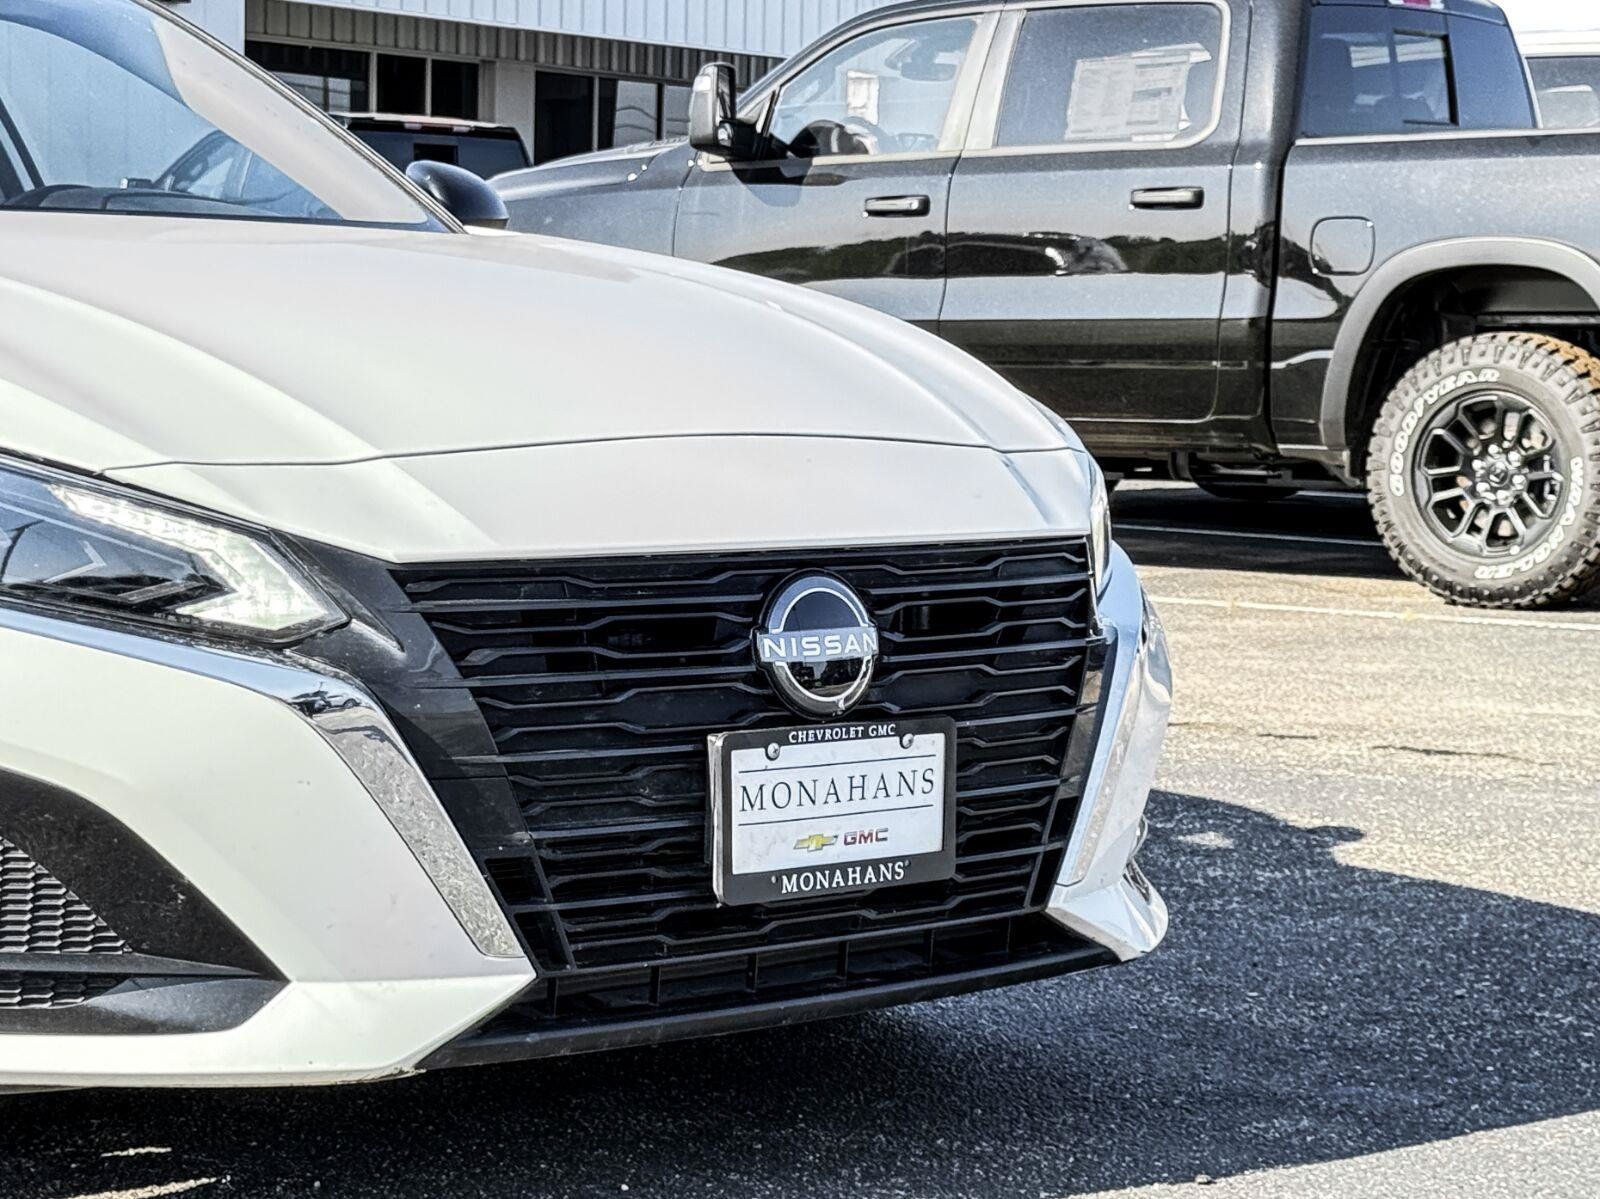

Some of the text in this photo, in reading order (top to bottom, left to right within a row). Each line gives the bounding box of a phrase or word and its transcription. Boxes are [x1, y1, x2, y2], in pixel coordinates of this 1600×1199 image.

[1389, 368, 1500, 497] GOODYEAR
[1474, 456, 1584, 579] WRANGLER
[763, 632, 878, 658] NISSAN
[788, 723, 896, 743] CHEVROLET GMC
[739, 767, 935, 812] MONAHANS
[843, 828, 889, 846] GMC
[781, 861, 905, 894] MONAHANS
